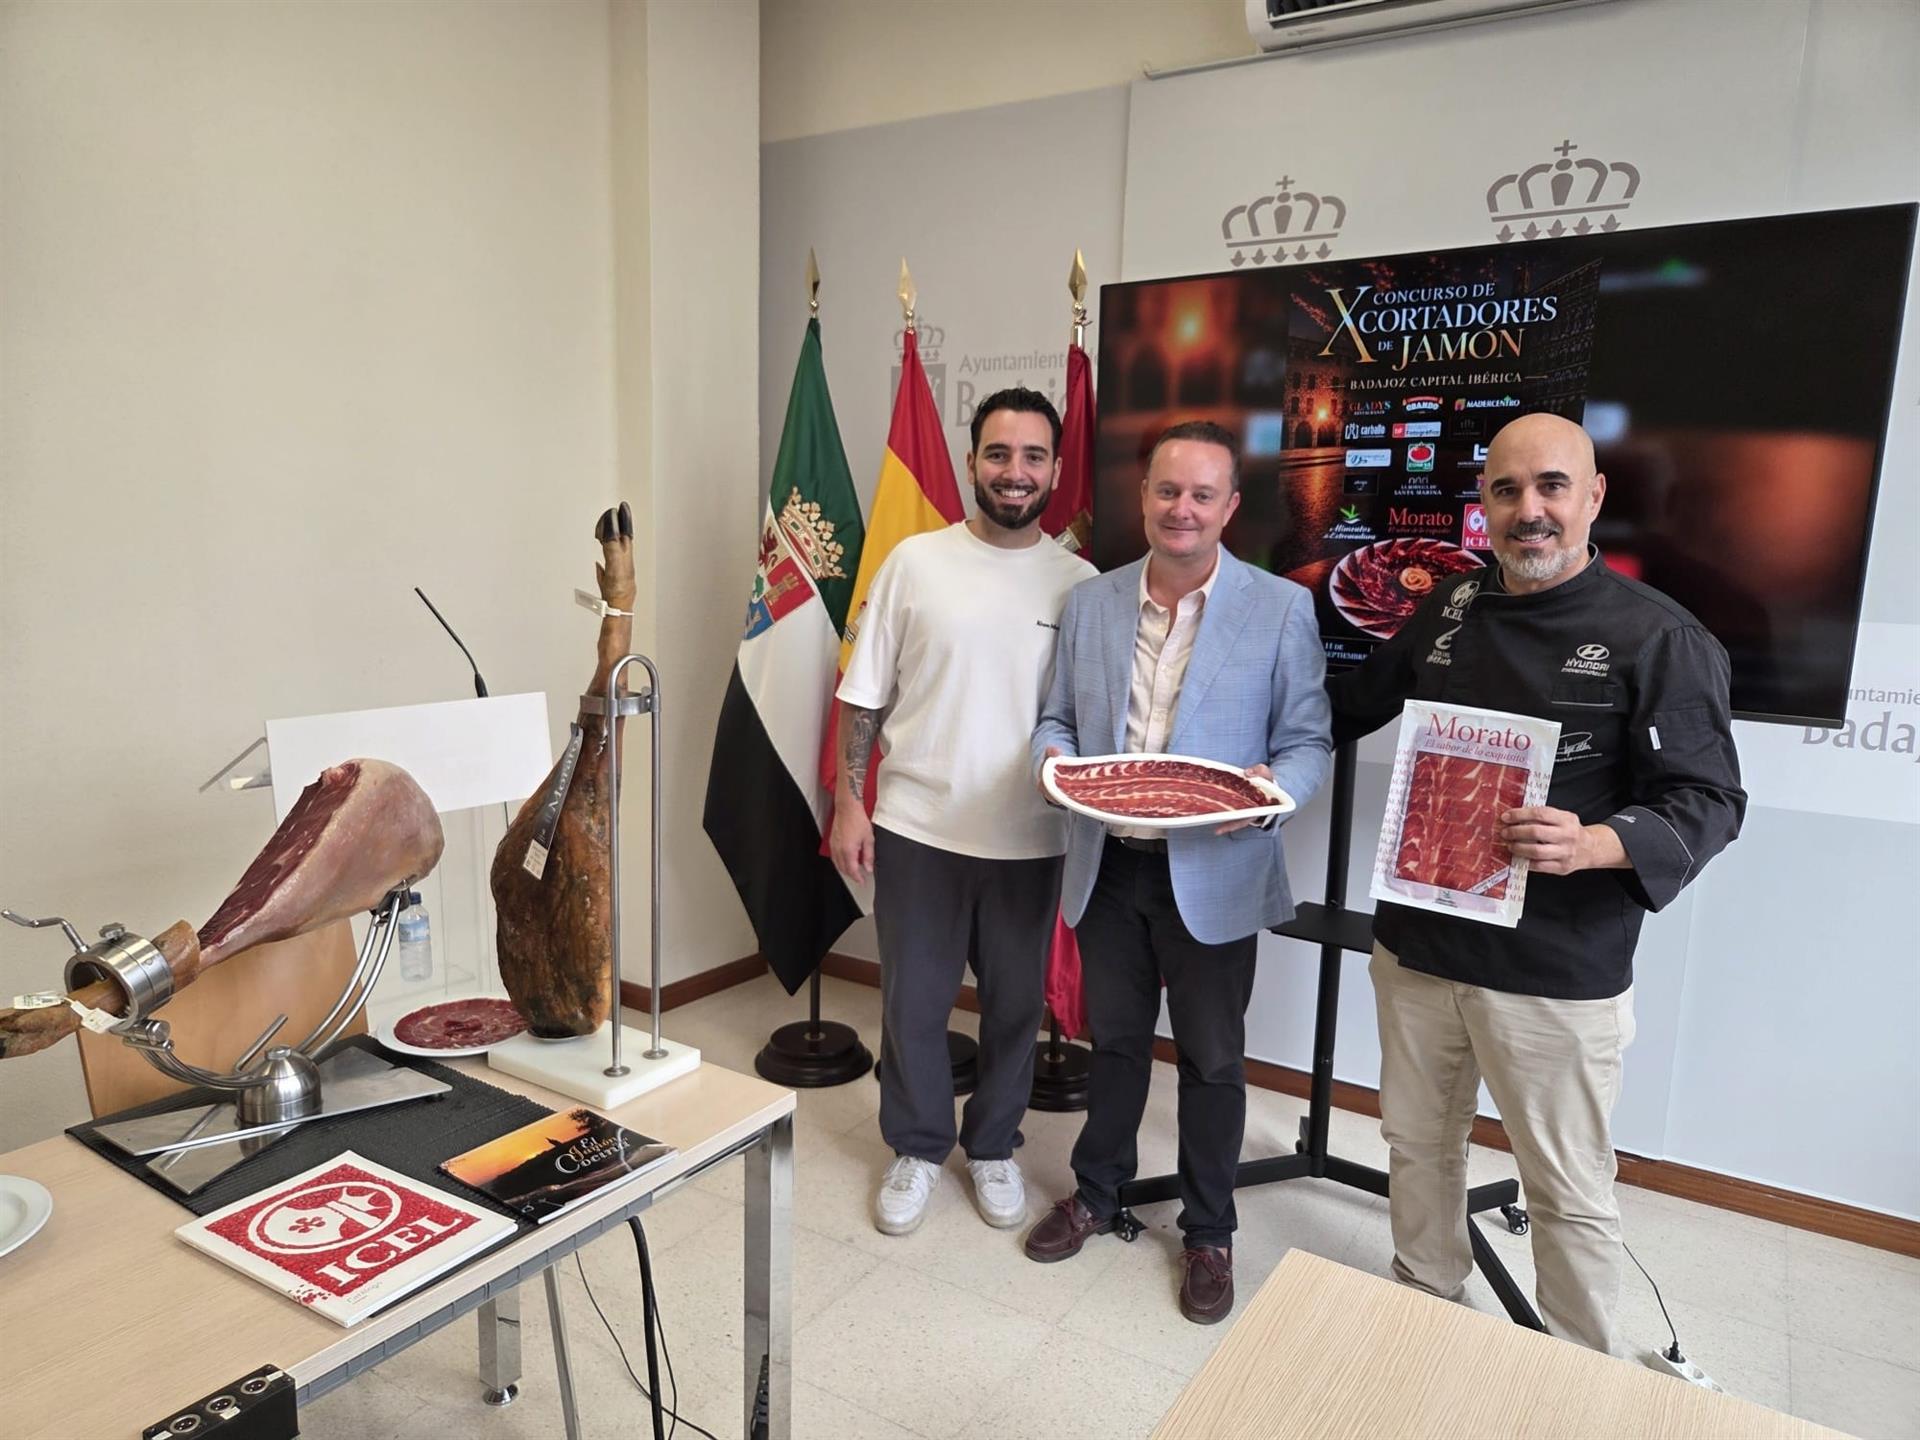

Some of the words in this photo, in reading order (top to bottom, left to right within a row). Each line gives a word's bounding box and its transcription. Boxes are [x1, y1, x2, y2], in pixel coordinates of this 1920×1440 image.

[1373, 285, 1468, 306] CONCURSO
[1472, 282, 1495, 297] DE
[1318, 285, 1378, 363] X
[1359, 296, 1558, 334] CORTADORES
[1378, 340, 1394, 351] DE
[1392, 325, 1525, 372] JAMÓN
[959, 350, 1067, 377] Ayuntamient
[1350, 377, 1407, 390] BADAJOZ
[1410, 374, 1465, 388] CAPITAL
[1468, 371, 1522, 385] IBÉRICA
[1349, 401, 1392, 411] GLADYS
[1466, 399, 1520, 408] MADERCENTRO
[1388, 507, 1454, 526] Morato
[1441, 605, 1464, 621] ICEL
[1565, 657, 1610, 671] HYUNDAI
[1426, 712, 1532, 752] Morato
[1436, 741, 1460, 752] sabor
[1461, 745, 1473, 754] de
[315, 1214, 463, 1287] ICEL
